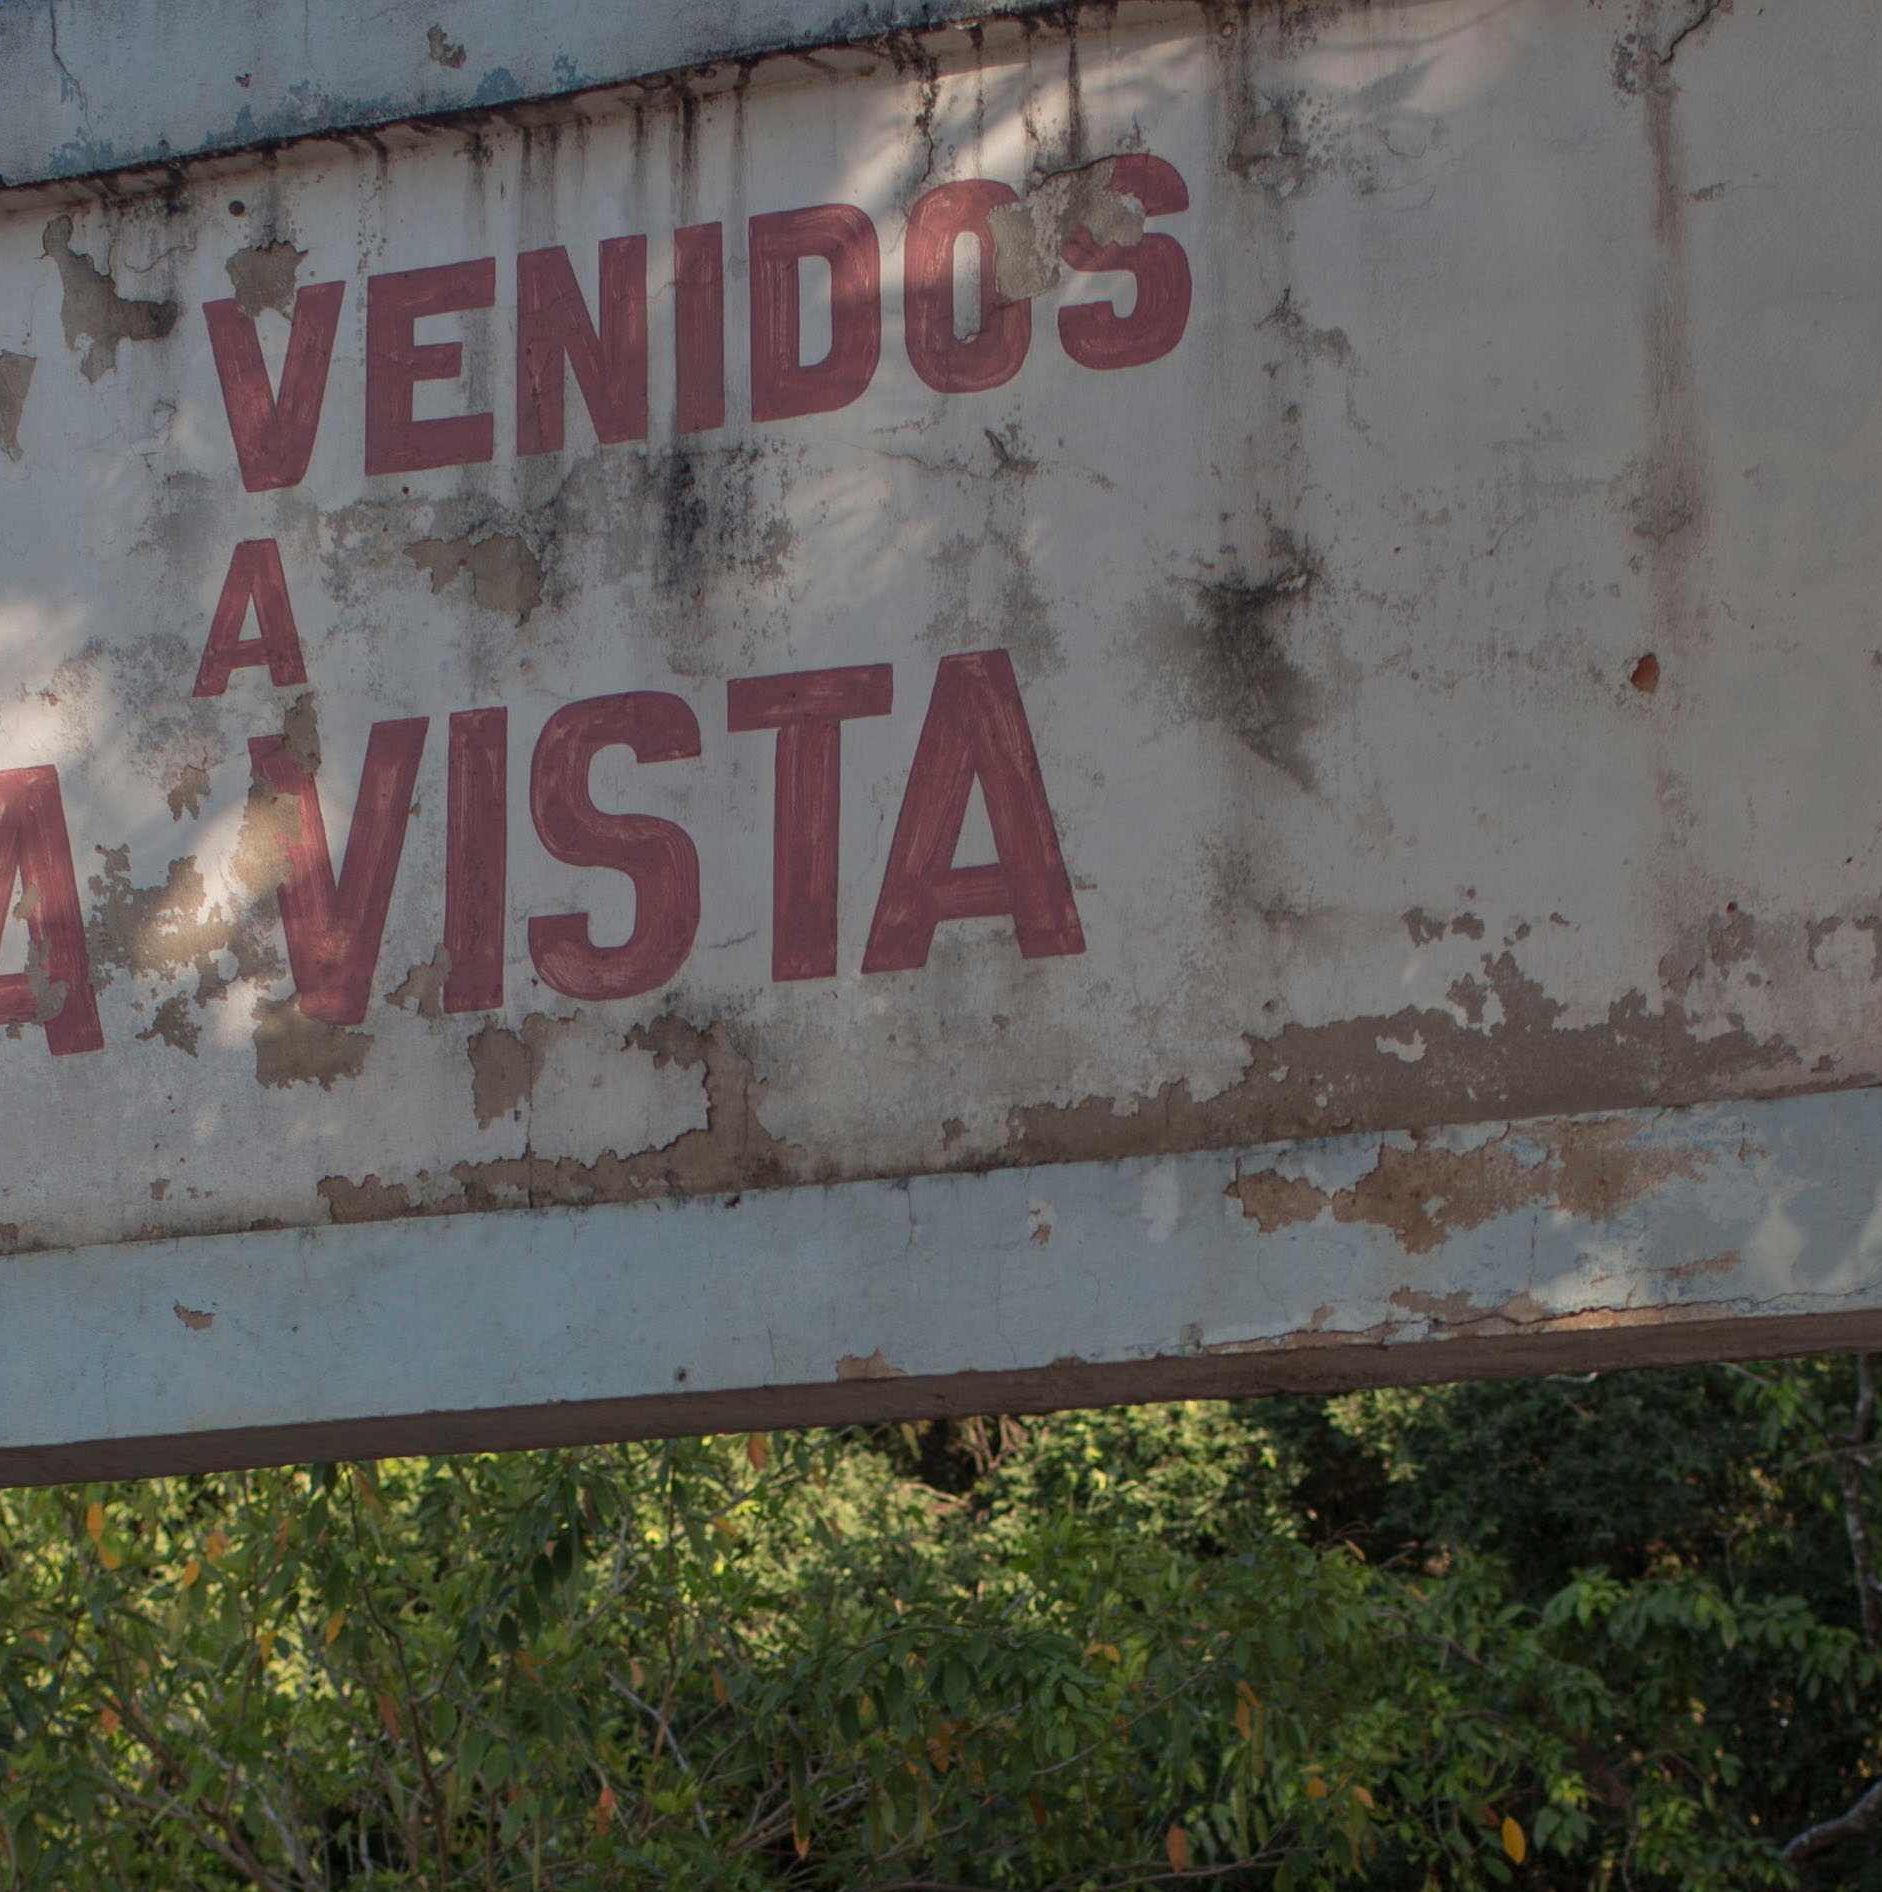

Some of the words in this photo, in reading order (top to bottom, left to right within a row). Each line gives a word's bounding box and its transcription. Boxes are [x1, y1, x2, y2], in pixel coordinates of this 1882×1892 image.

[202, 152, 1194, 493] VENIDOS
[193, 537, 308, 699] A
[248, 648, 1088, 1026] VISTA
